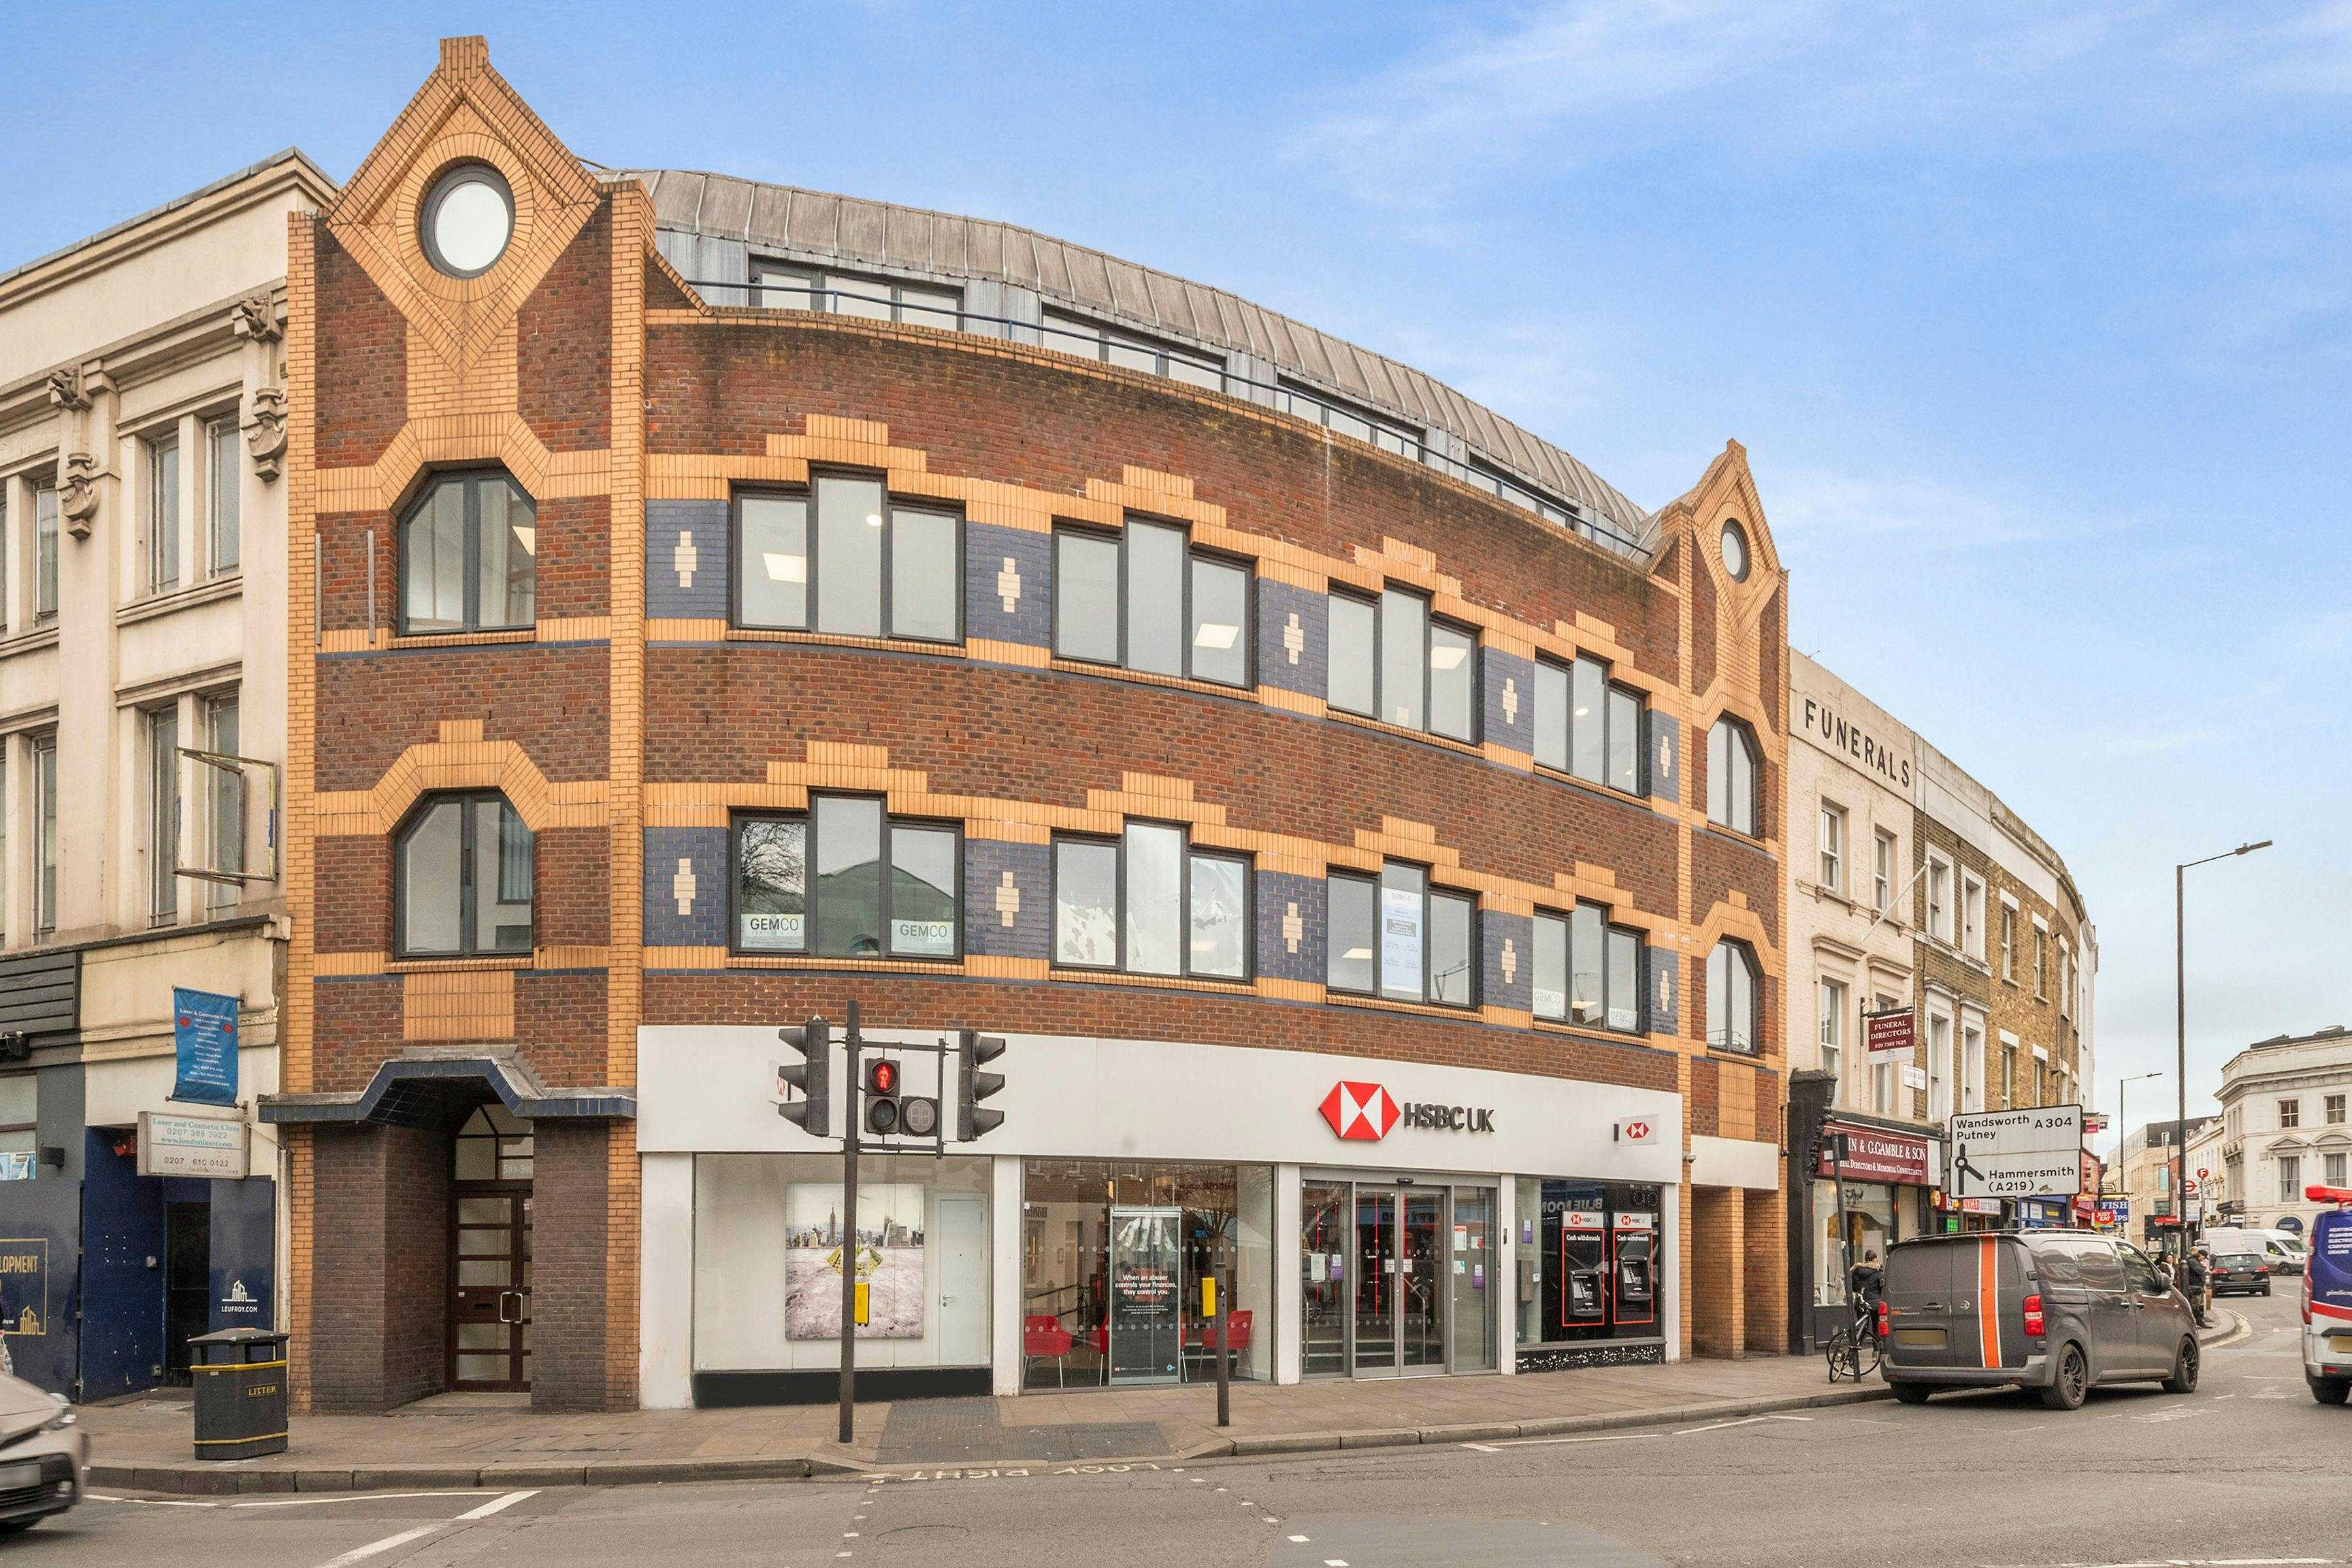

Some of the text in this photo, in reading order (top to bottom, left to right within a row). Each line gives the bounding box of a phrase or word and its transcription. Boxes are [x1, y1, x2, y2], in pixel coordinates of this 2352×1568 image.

[1805, 699, 1910, 788] FUNERALS
[750, 917, 799, 931] GEMCO
[900, 924, 947, 938] GEMCO
[1534, 991, 1561, 1004] GEMCO
[1612, 1011, 1634, 1024] GEMCO
[1874, 1020, 1908, 1030] FUNERAL
[1870, 1028, 1912, 1040] DIRECTORS
[1404, 1102, 1495, 1132] HSBC UK
[1957, 1115, 2029, 1129] Wandsworth
[152, 1117, 240, 1132] Laser and Cosmetic Clinic
[208, 1130, 227, 1139] 3922
[1957, 1130, 1996, 1141] Putney
[161, 1137, 233, 1148] www.londonlaser.com
[1859, 1139, 1866, 1153] &
[1906, 1147, 1912, 1159] &
[1912, 1147, 1927, 1161] SON
[164, 1156, 229, 1168] 0207 610 0122
[1989, 1166, 2074, 1179] Hammersmith
[1989, 1179, 2035, 1192] (A219)
[2102, 1201, 2127, 1209] FISH
[1577, 1234, 1601, 1242] withdrawals
[248, 1385, 277, 1396] LITTER
[902, 1463, 1161, 1482] LOOK RIGHT
